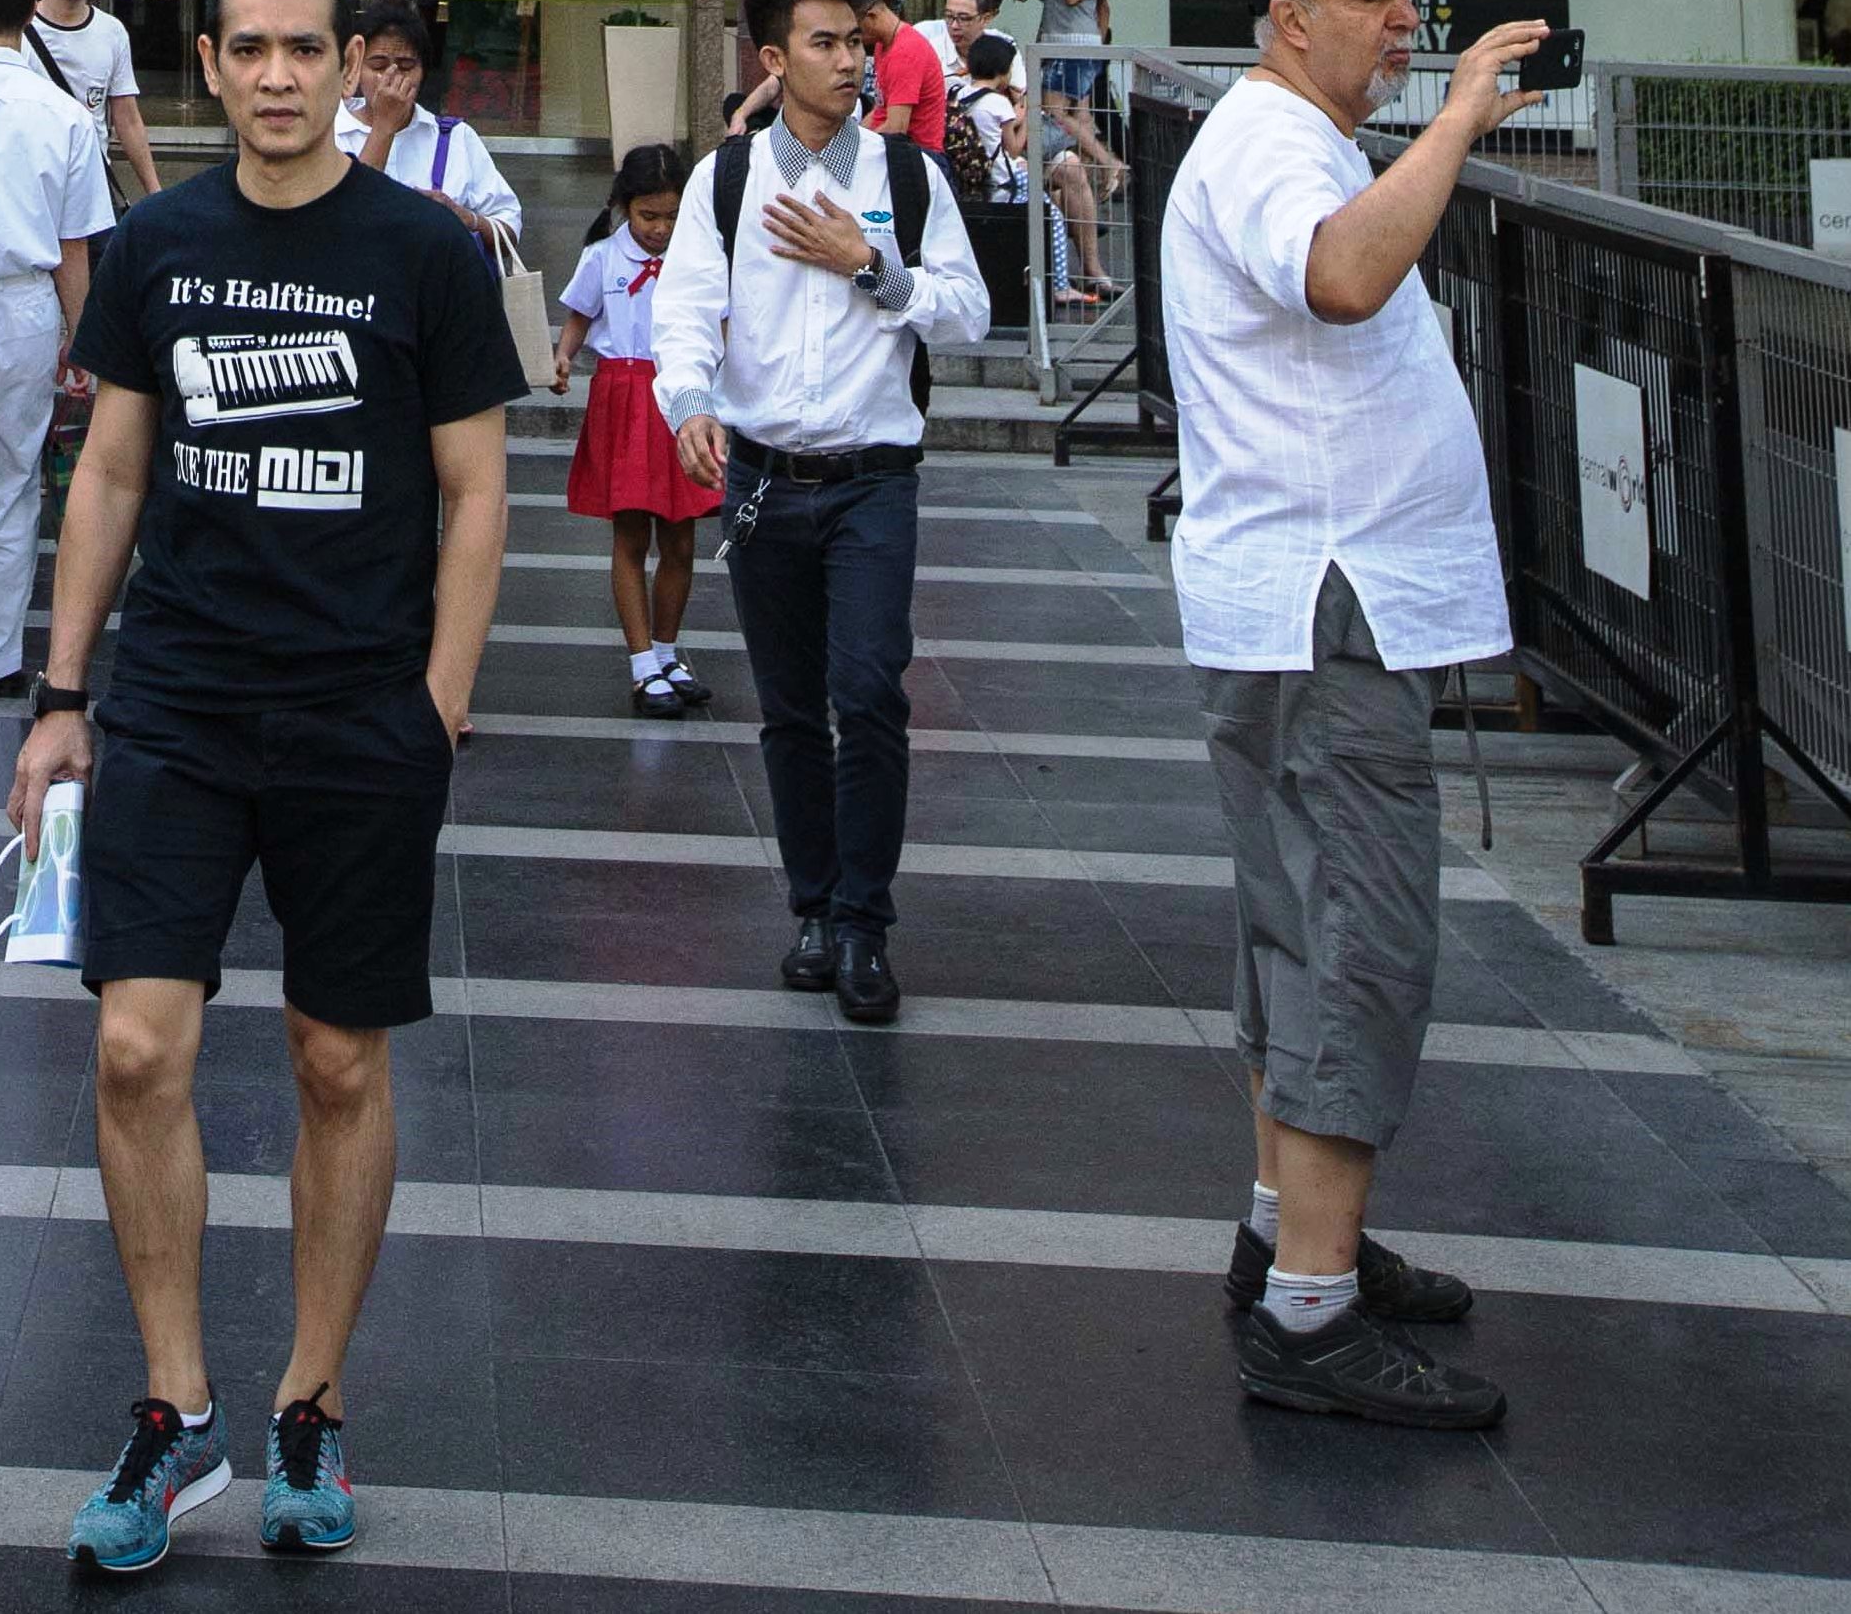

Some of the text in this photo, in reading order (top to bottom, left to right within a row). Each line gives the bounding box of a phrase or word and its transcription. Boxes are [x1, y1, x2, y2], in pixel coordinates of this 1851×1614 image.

[169, 277, 375, 322] It's Halftime!
[205, 448, 250, 495] THE
[257, 446, 364, 493] MIDI
